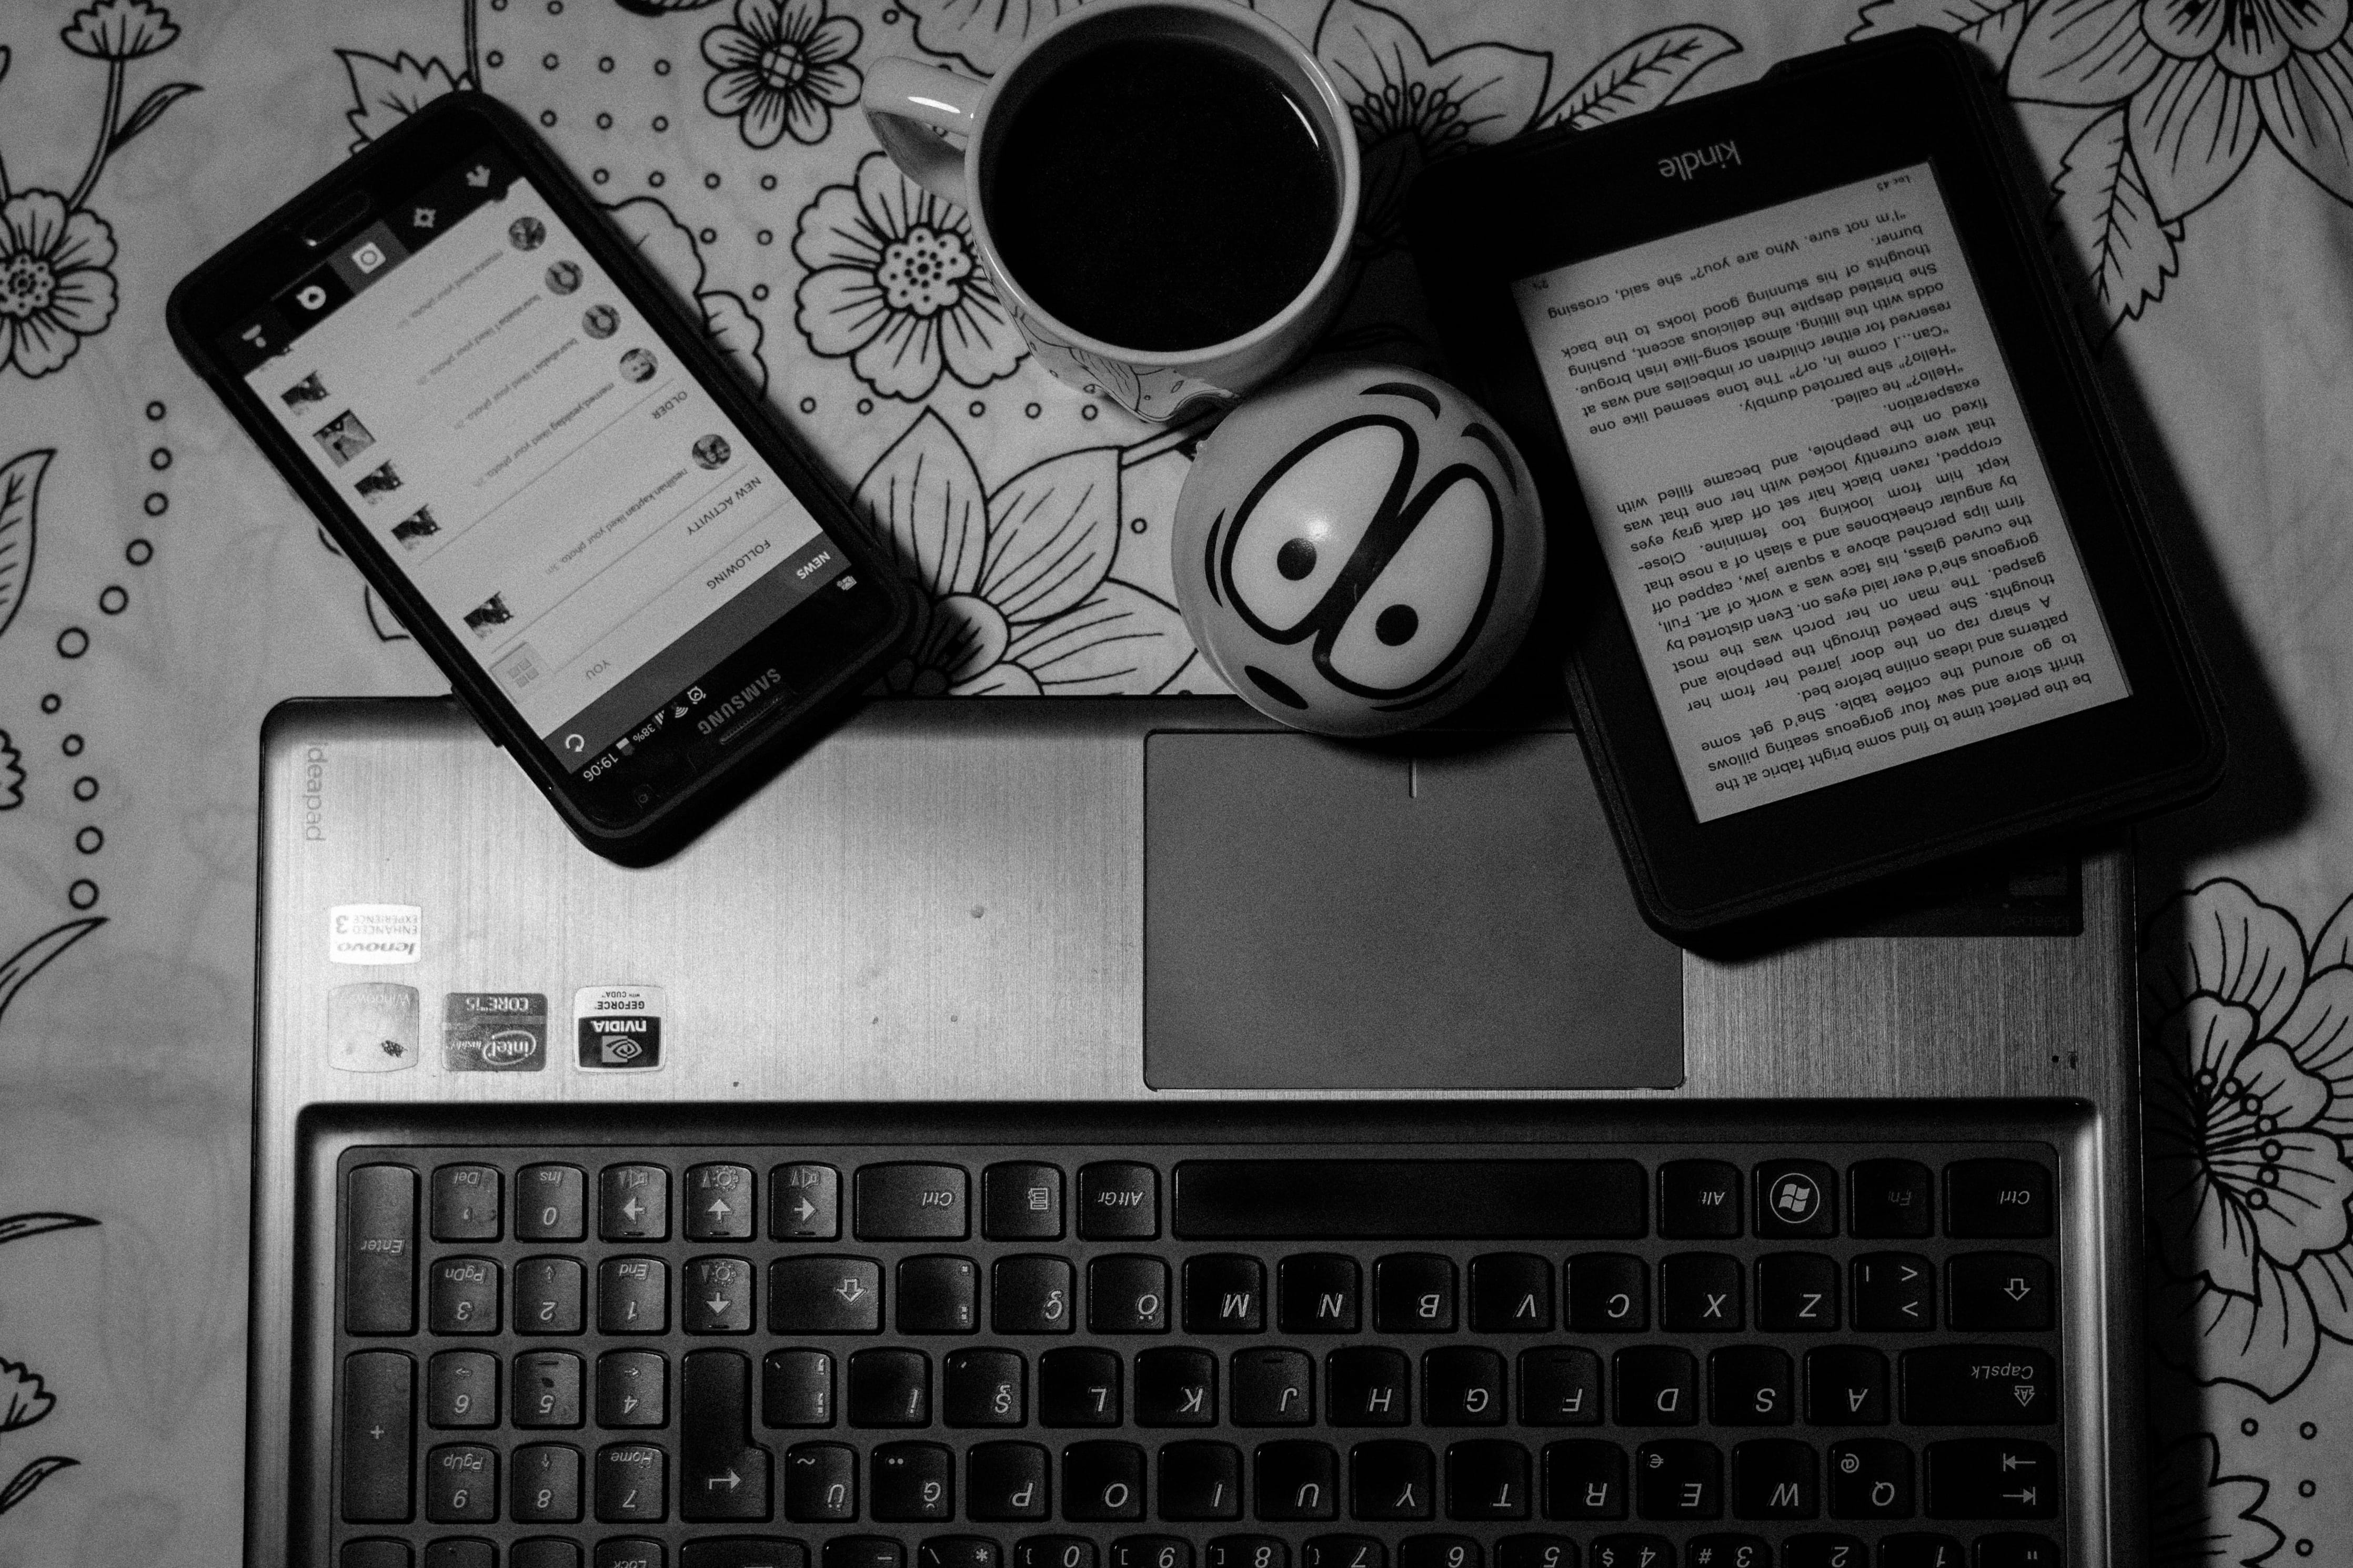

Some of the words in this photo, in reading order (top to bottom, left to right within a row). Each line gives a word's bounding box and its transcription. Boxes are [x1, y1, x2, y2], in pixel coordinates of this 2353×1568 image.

[1658, 139, 1742, 180] kindle
[1804, 227, 1841, 243] sure.
[1845, 219, 1869, 234] not
[1736, 250, 1759, 264] are
[1765, 240, 1799, 256] Who
[1657, 273, 1683, 287] she
[1615, 282, 1651, 300] said,
[1907, 282, 1944, 299] odds
[1547, 295, 1610, 319] crossing
[1845, 304, 1869, 317] the
[1872, 294, 1904, 311] with
[1796, 312, 1841, 331] lilting,
[1743, 326, 1792, 349] almost
[1673, 342, 1739, 368] song-like
[1635, 362, 1668, 380] Irish
[1575, 372, 1632, 394] brogue.
[650, 389, 688, 420] OLDER
[1976, 455, 2010, 474] kept
[1935, 469, 1964, 484] him
[733, 476, 761, 499] NEW
[1887, 482, 1922, 499] from
[685, 495, 736, 535] ACTIVITY
[1819, 496, 1874, 519] looking
[604, 513, 627, 532] liked
[1781, 515, 1806, 530] too
[585, 526, 606, 544] your
[1700, 527, 1768, 552] feminine.
[1970, 531, 2039, 561] gorgeous
[705, 539, 771, 590] FOLLOWING
[795, 551, 831, 580] NEWS
[1638, 551, 1686, 570] Close-
[1893, 568, 1924, 585] ever
[1824, 587, 1858, 605] eyes
[1861, 579, 1889, 596] laid
[1797, 599, 1820, 611] on.
[1757, 606, 1794, 624] Even
[2008, 610, 2069, 638] patterns
[1687, 619, 1754, 648] distorted
[1976, 632, 2005, 650] and
[2061, 633, 2077, 644] to
[1666, 639, 1685, 652] by
[1933, 641, 1974, 660] ideas
[2033, 637, 2053, 652] go
[584, 657, 610, 680] YOU
[1885, 654, 1930, 674] online
[1972, 648, 2024, 674] around
[2048, 653, 2085, 673] thrift
[1834, 669, 1883, 690] before
[1940, 666, 1965, 680] the
[2006, 665, 2043, 683] store
[2072, 672, 2092, 685] be
[1797, 684, 1832, 702] bed.
[1885, 676, 1931, 696] coffee
[1971, 677, 2000, 696] and
[2044, 680, 2069, 694] the
[695, 666, 782, 736] SAMSUNG
[1835, 692, 1878, 711] table.
[1937, 688, 1966, 704] sew
[1987, 685, 2040, 713] perfect
[1901, 699, 1930, 715] four
[1952, 704, 1986, 721] time
[1749, 720, 1774, 740] get
[1825, 707, 1894, 737] gorgeous
[1900, 721, 1930, 740] find
[1933, 715, 1950, 727] to
[631, 723, 656, 743] 38%
[1701, 733, 1742, 751] some
[1856, 731, 1896, 750] some
[1765, 732, 1819, 755] seating
[1707, 746, 1760, 772] pillows
[1807, 744, 1853, 766] bright
[581, 751, 619, 782] 19:06
[1762, 758, 1805, 778] fabric
[1715, 778, 1740, 792] the
[1742, 772, 1758, 786] at
[336, 915, 348, 934] 3
[353, 926, 417, 934] ENHANCED
[337, 943, 415, 955] lenovo
[466, 997, 480, 1011] i5
[488, 997, 529, 1012] CORE
[597, 1001, 645, 1009] GEFORCE
[590, 1020, 647, 1033] NVIDIA
[490, 1041, 529, 1057] intel
[454, 1172, 478, 1184] Del
[540, 1172, 562, 1185] Ins
[923, 1192, 952, 1206] Ctrl
[1703, 1192, 1725, 1205] Alt
[2000, 1191, 2029, 1204] Ctrl
[361, 1240, 403, 1253] Enter
[446, 1266, 484, 1284] PgDn
[620, 1264, 647, 1278] End
[1139, 1294, 1158, 1319] Ö
[1223, 1294, 1249, 1317] M
[1321, 1294, 1342, 1317] N
[1420, 1294, 1439, 1317] B
[1517, 1294, 1535, 1317] V
[1608, 1294, 1629, 1317] C
[1704, 1294, 1726, 1317] X
[1799, 1294, 1821, 1317] Z
[1972, 1363, 2033, 1379] CapsLk
[1089, 1389, 1106, 1411] L
[1181, 1389, 1203, 1411] K
[1281, 1388, 1297, 1411] J
[1370, 1389, 1391, 1411] H
[1467, 1389, 1488, 1412] G
[1563, 1389, 1582, 1411] F
[1658, 1389, 1678, 1411] D
[1756, 1389, 1775, 1412] S
[1849, 1389, 1867, 1411] A
[444, 1453, 482, 1470] PgUp
[610, 1449, 652, 1465] Home
[1012, 1483, 1033, 1506] P
[1105, 1484, 1128, 1507] O
[1298, 1484, 1319, 1506] U
[1396, 1484, 1415, 1506] Y
[1493, 1484, 1511, 1506] T
[1586, 1483, 1607, 1505] R
[1682, 1484, 1702, 1506] E
[1771, 1483, 1798, 1506] W
[1872, 1482, 1894, 1506] Q
